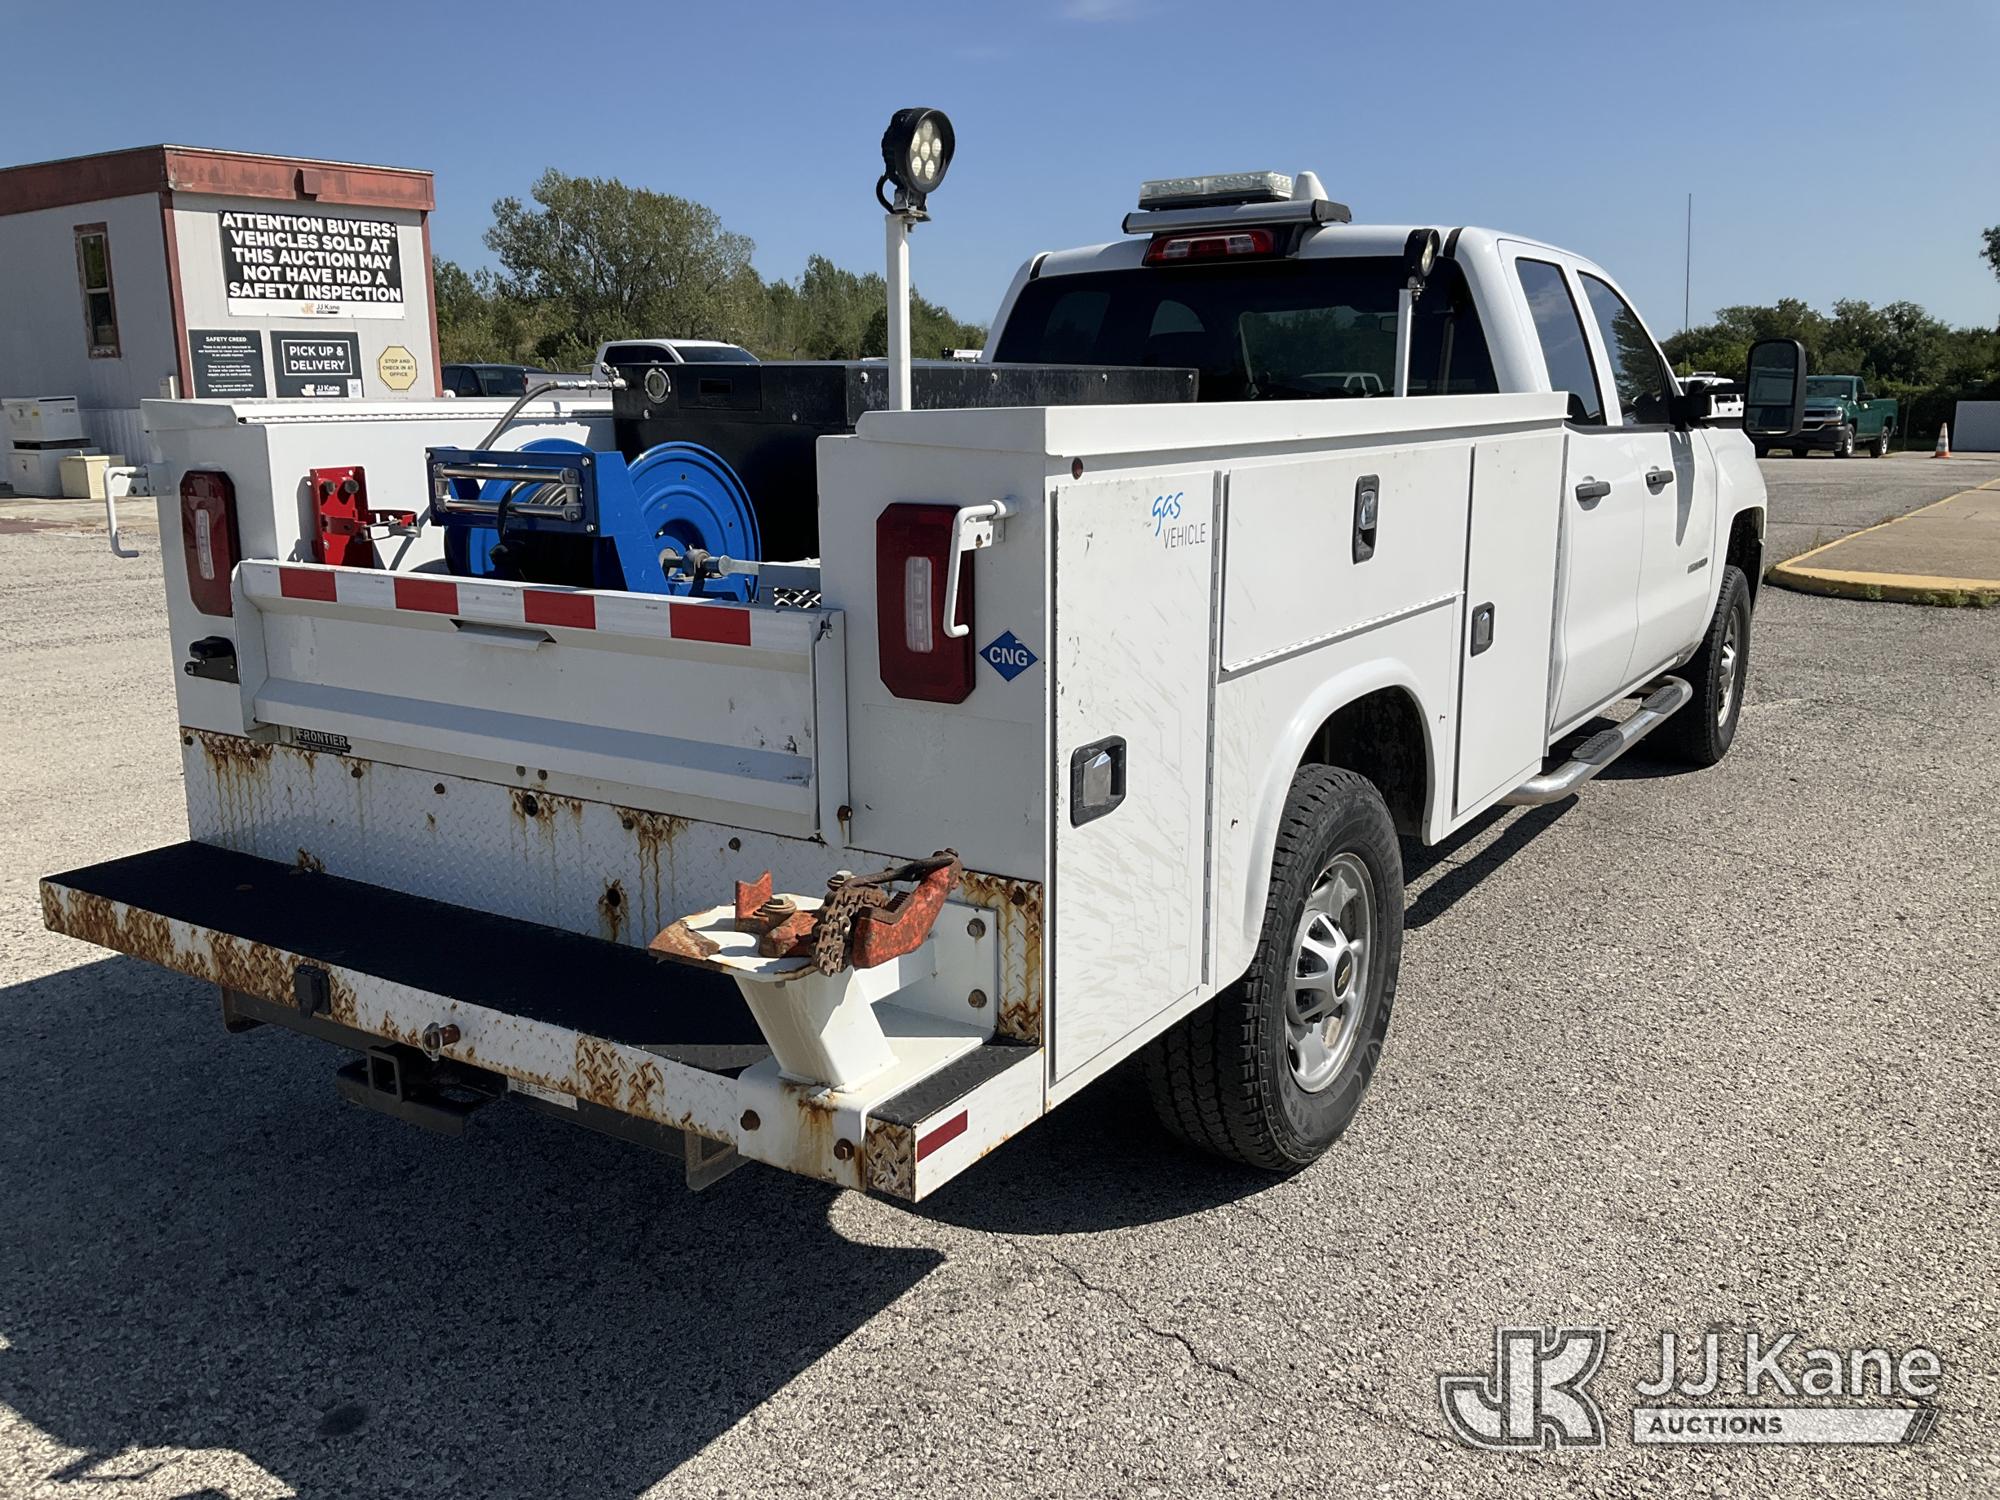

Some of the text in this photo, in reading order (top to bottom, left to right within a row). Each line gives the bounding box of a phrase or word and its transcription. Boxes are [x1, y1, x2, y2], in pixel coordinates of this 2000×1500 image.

[222, 212, 396, 238] ATTENTION BUYERS:
[230, 229, 390, 254] VEHICLES SOLD AT
[231, 247, 392, 270] THIS AUCTION MAY
[242, 265, 388, 285] NOT HAVE HAD A
[229, 282, 401, 302] SAFETY INSPECTION
[289, 345, 344, 357] PICK UP &
[290, 360, 345, 371] DELIVERY
[1151, 491, 1184, 537] gas
[1162, 522, 1206, 549] VEHICLE
[989, 646, 1028, 667] CNG
[295, 729, 346, 747] FRONTIER
